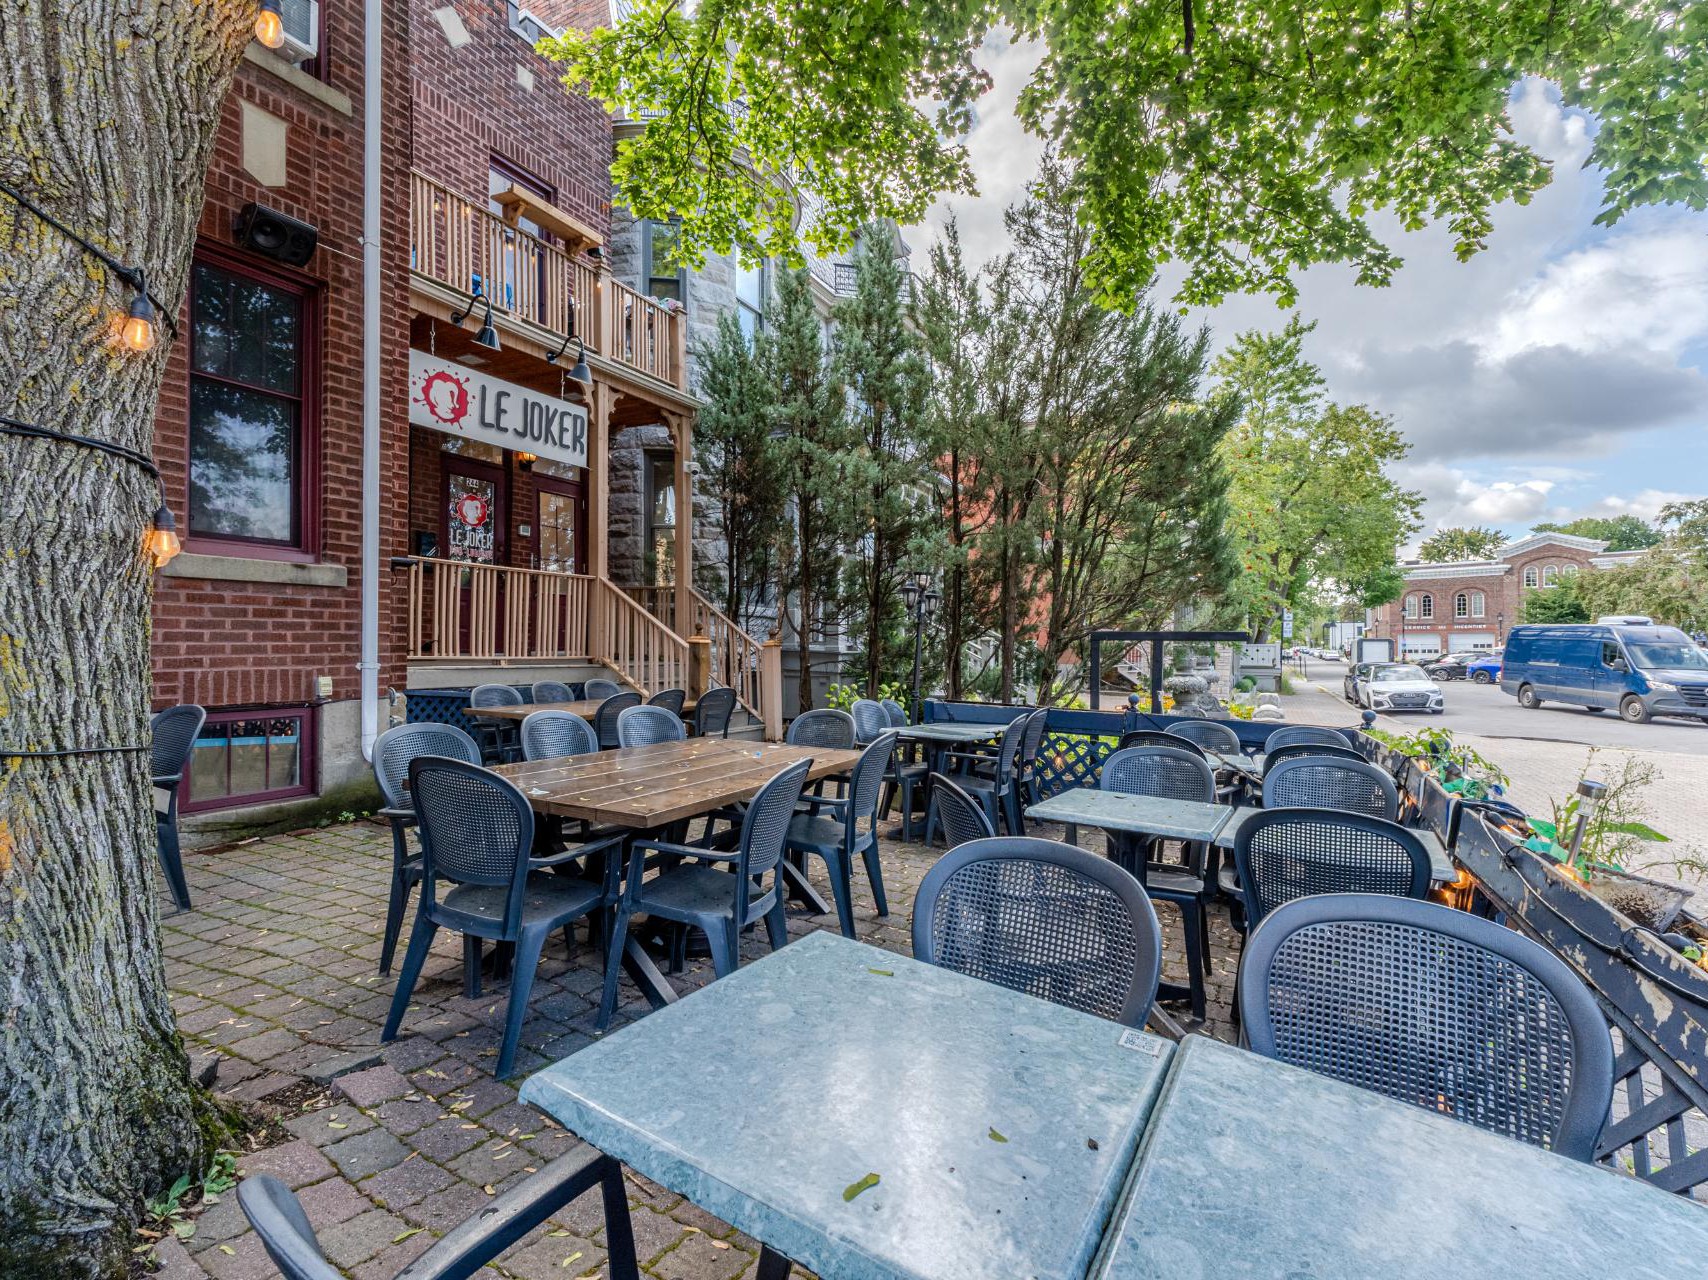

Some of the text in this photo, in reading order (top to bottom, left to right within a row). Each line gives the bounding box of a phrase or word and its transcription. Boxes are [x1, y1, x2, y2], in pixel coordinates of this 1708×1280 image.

[479, 384, 585, 455] LE JOKER
[467, 478, 478, 487] 244
[450, 528, 493, 550] LE JOKER
